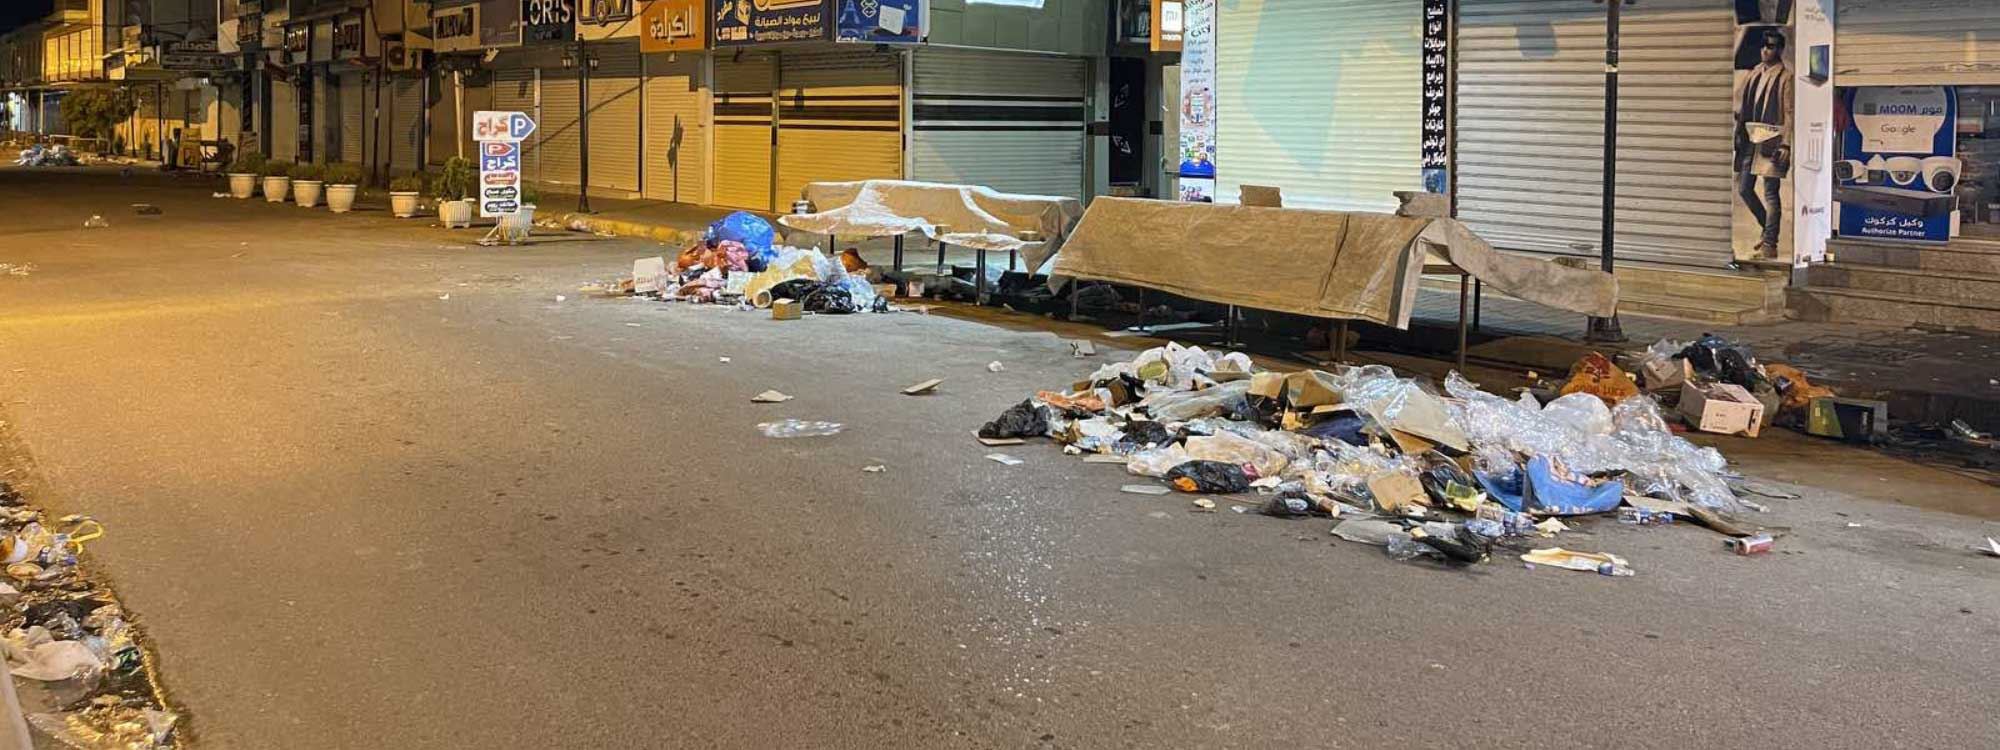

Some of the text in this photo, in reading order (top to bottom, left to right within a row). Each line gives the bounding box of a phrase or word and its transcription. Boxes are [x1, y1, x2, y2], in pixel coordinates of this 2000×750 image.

[521, 0, 572, 25] ORIS
[650, 4, 692, 43] الكرادة
[754, 16, 782, 28] الصيانة
[783, 16, 801, 27] مواد
[1879, 104, 1917, 115] MOOM
[514, 118, 526, 136] P
[1880, 123, 1917, 136] Gogle
[488, 144, 502, 155] P
[1898, 217, 1924, 228] وكيل
[1861, 226, 1925, 237] Authorize Partner
